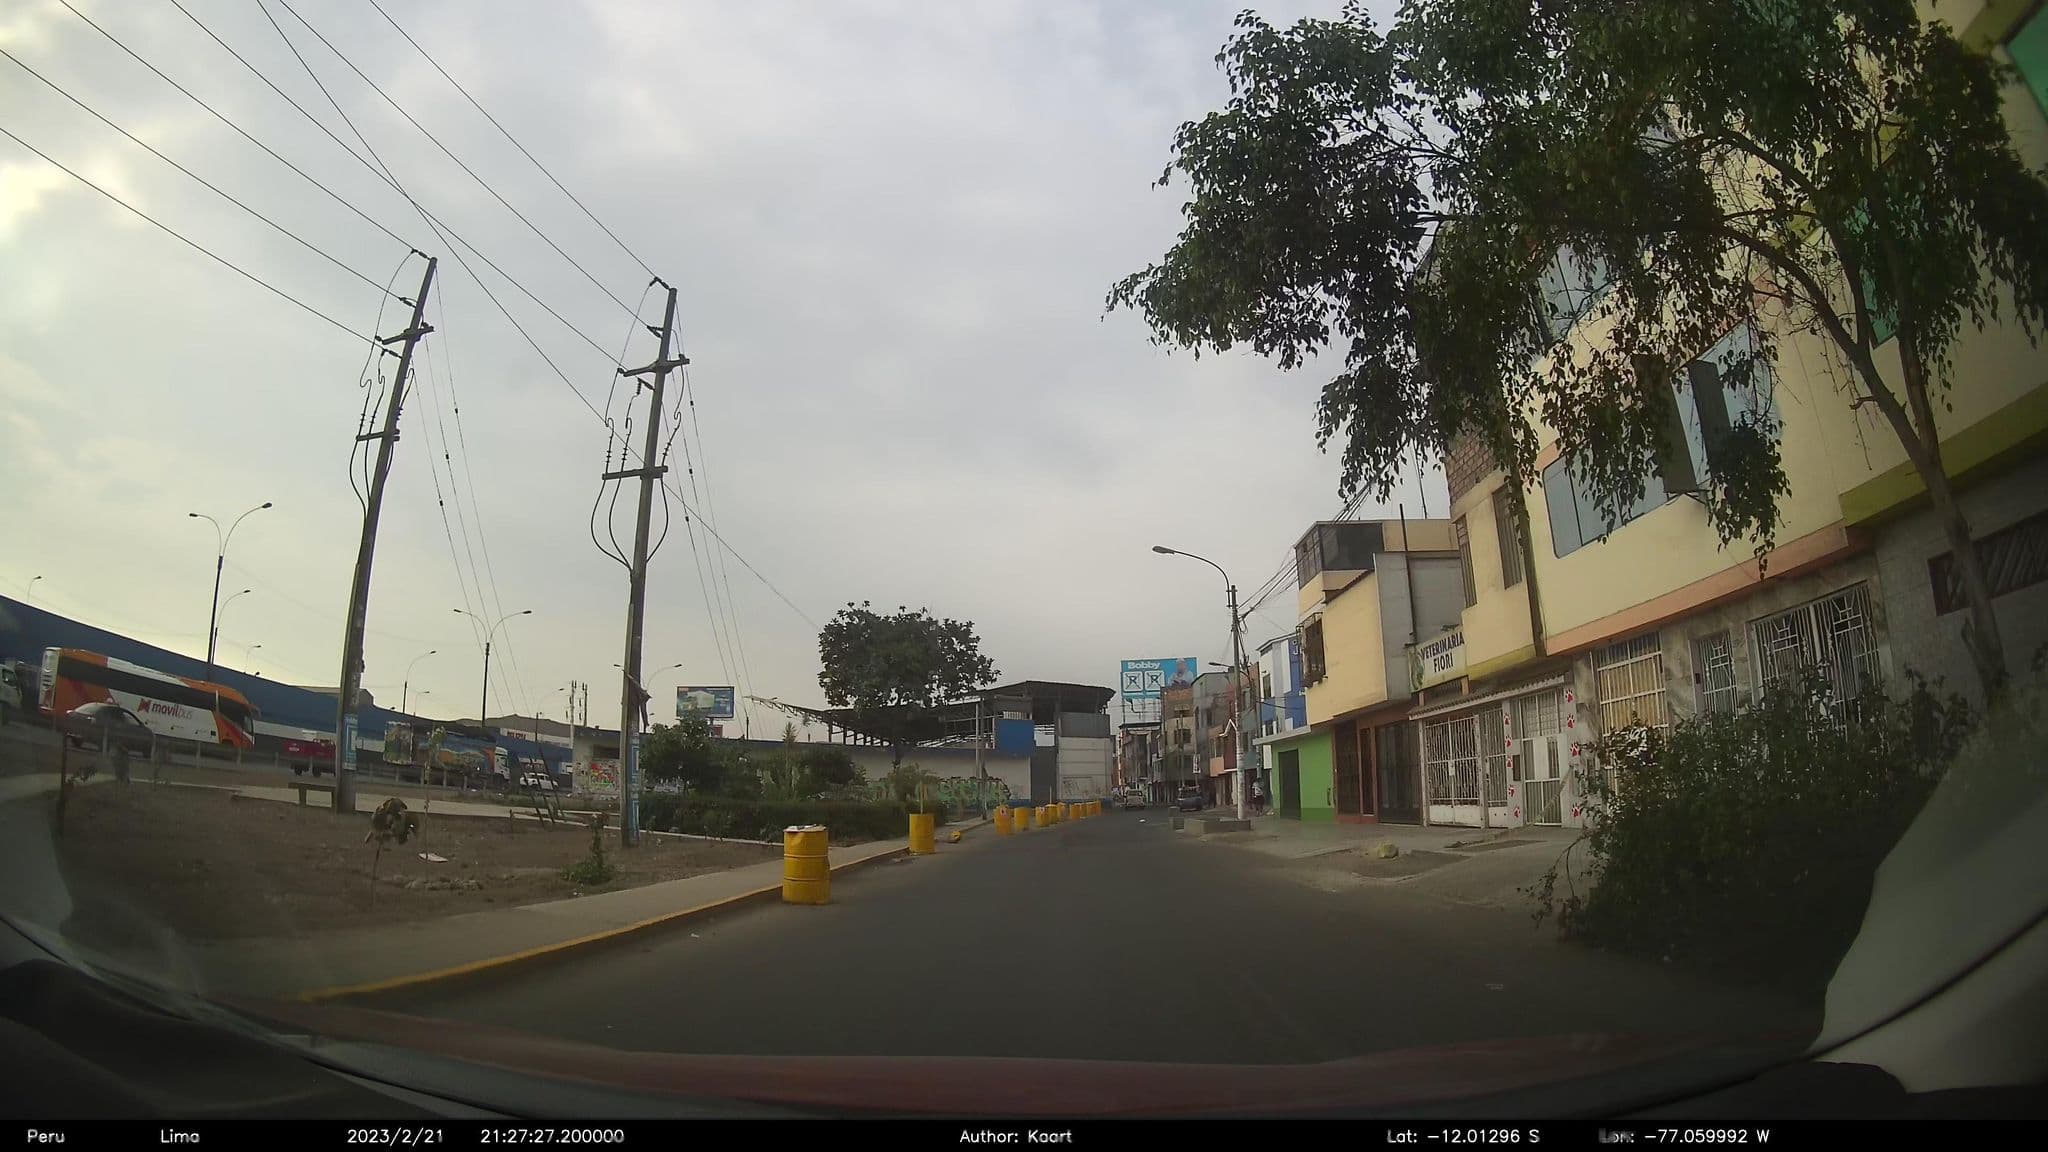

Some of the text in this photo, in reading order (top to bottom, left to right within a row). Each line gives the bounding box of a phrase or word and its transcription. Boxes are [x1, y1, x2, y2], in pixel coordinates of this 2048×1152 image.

[1419, 632, 1465, 660] VETERINARIA
[1127, 661, 1161, 670] Bobby
[1433, 652, 1454, 672] FIORI
[151, 702, 193, 720] movilbus
